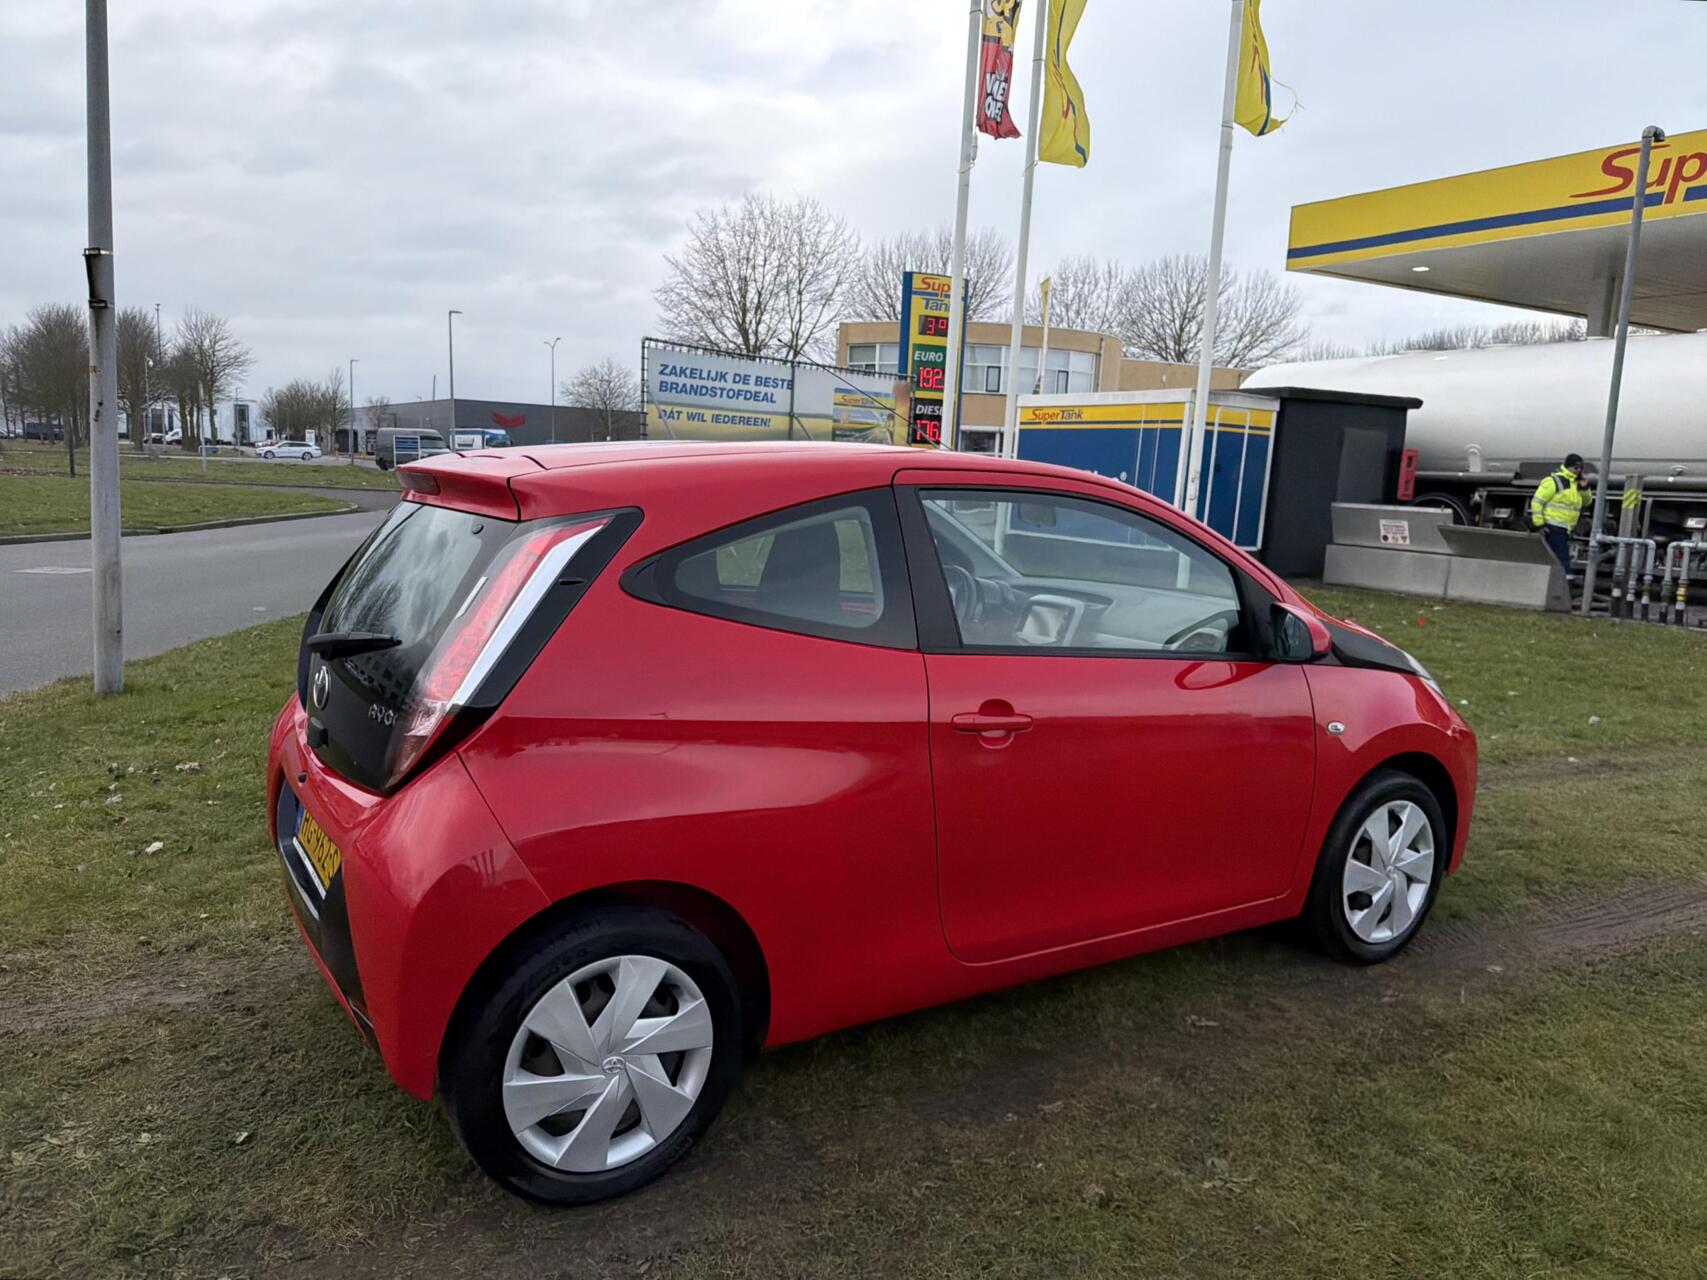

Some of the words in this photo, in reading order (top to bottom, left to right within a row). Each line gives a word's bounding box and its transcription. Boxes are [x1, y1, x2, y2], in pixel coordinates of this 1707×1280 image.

[914, 350, 943, 362] EURO
[659, 363, 729, 382] ZAKELIJK
[732, 373, 751, 385] DE
[754, 375, 793, 390] BESTE
[659, 380, 777, 403] BRANDSTOFDEAL
[686, 411, 707, 423] WIL
[711, 413, 771, 427] IEDEREEN!
